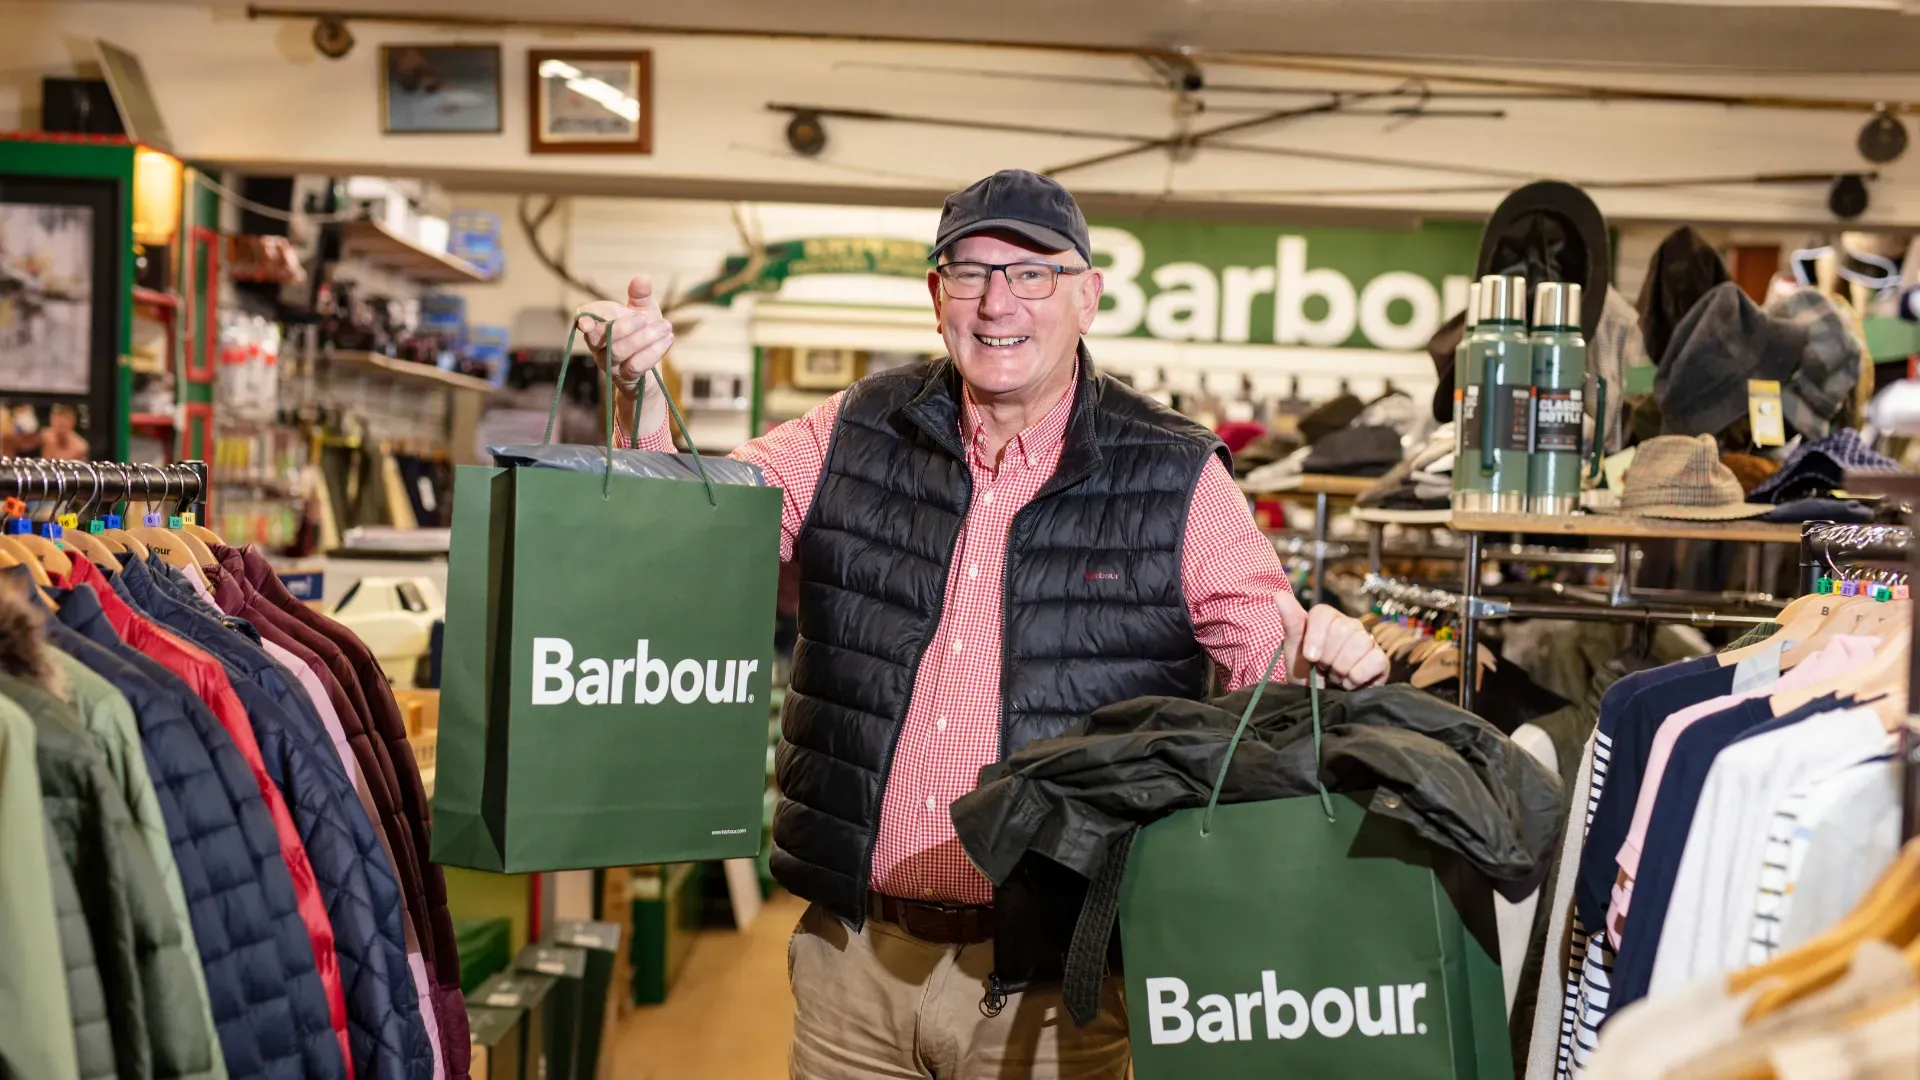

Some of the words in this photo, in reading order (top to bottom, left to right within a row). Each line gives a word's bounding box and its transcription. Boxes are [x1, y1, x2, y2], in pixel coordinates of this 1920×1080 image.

[1538, 411, 1581, 424] BOTTLE
[532, 637, 758, 706] Barbour
[1146, 970, 1427, 1045] Barbour
